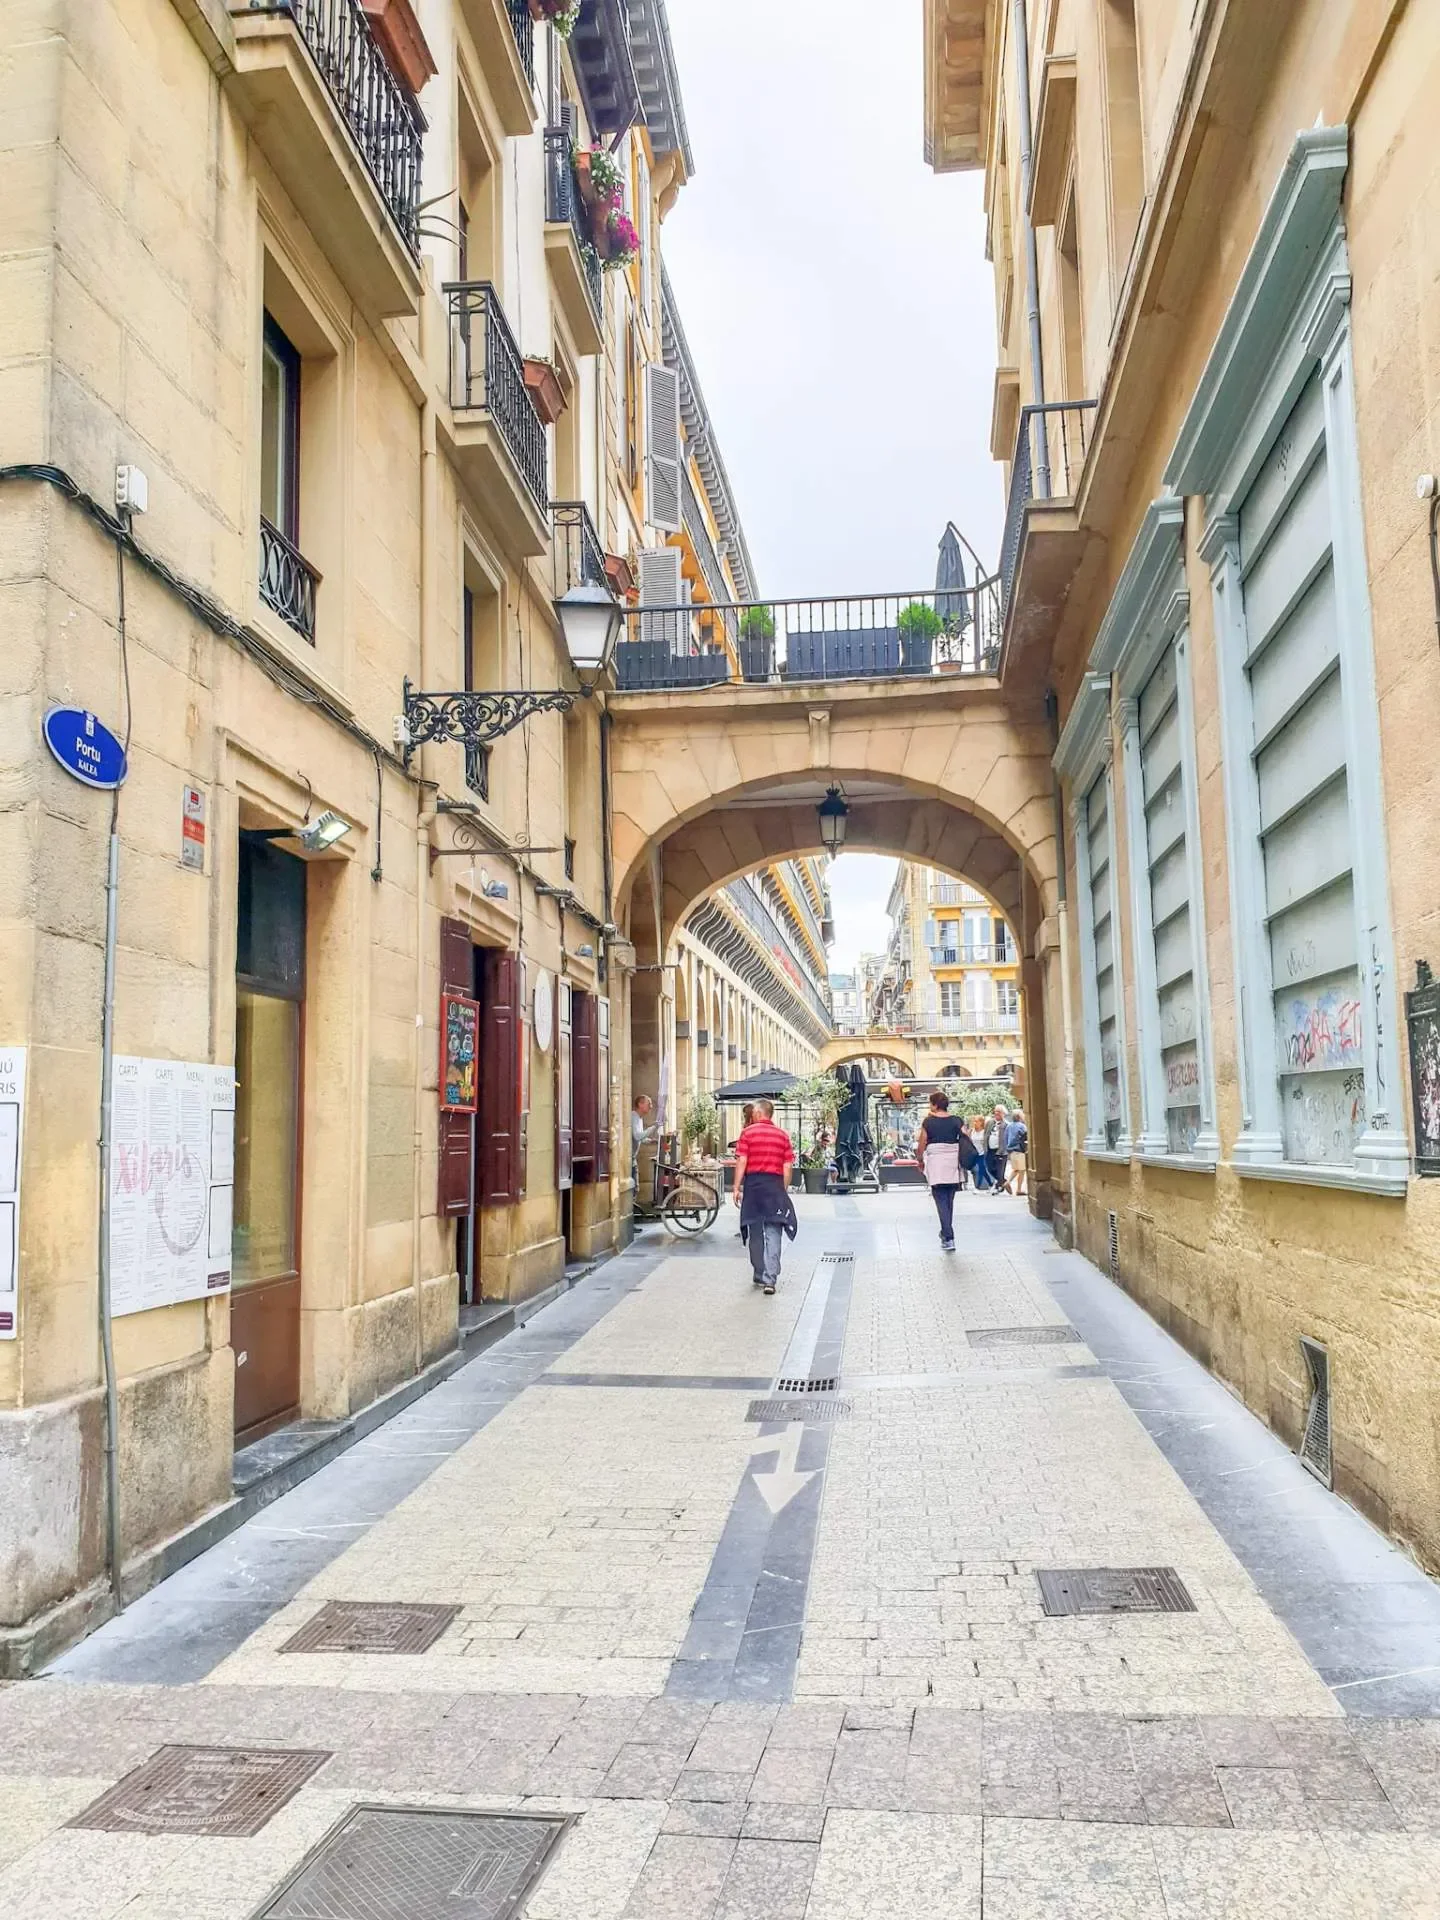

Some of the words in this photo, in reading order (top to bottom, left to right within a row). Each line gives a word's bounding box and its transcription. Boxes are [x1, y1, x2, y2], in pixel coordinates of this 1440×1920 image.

[76, 736, 100, 763] Portu
[78, 758, 98, 777] KALEA
[118, 1064, 139, 1076] CARTA
